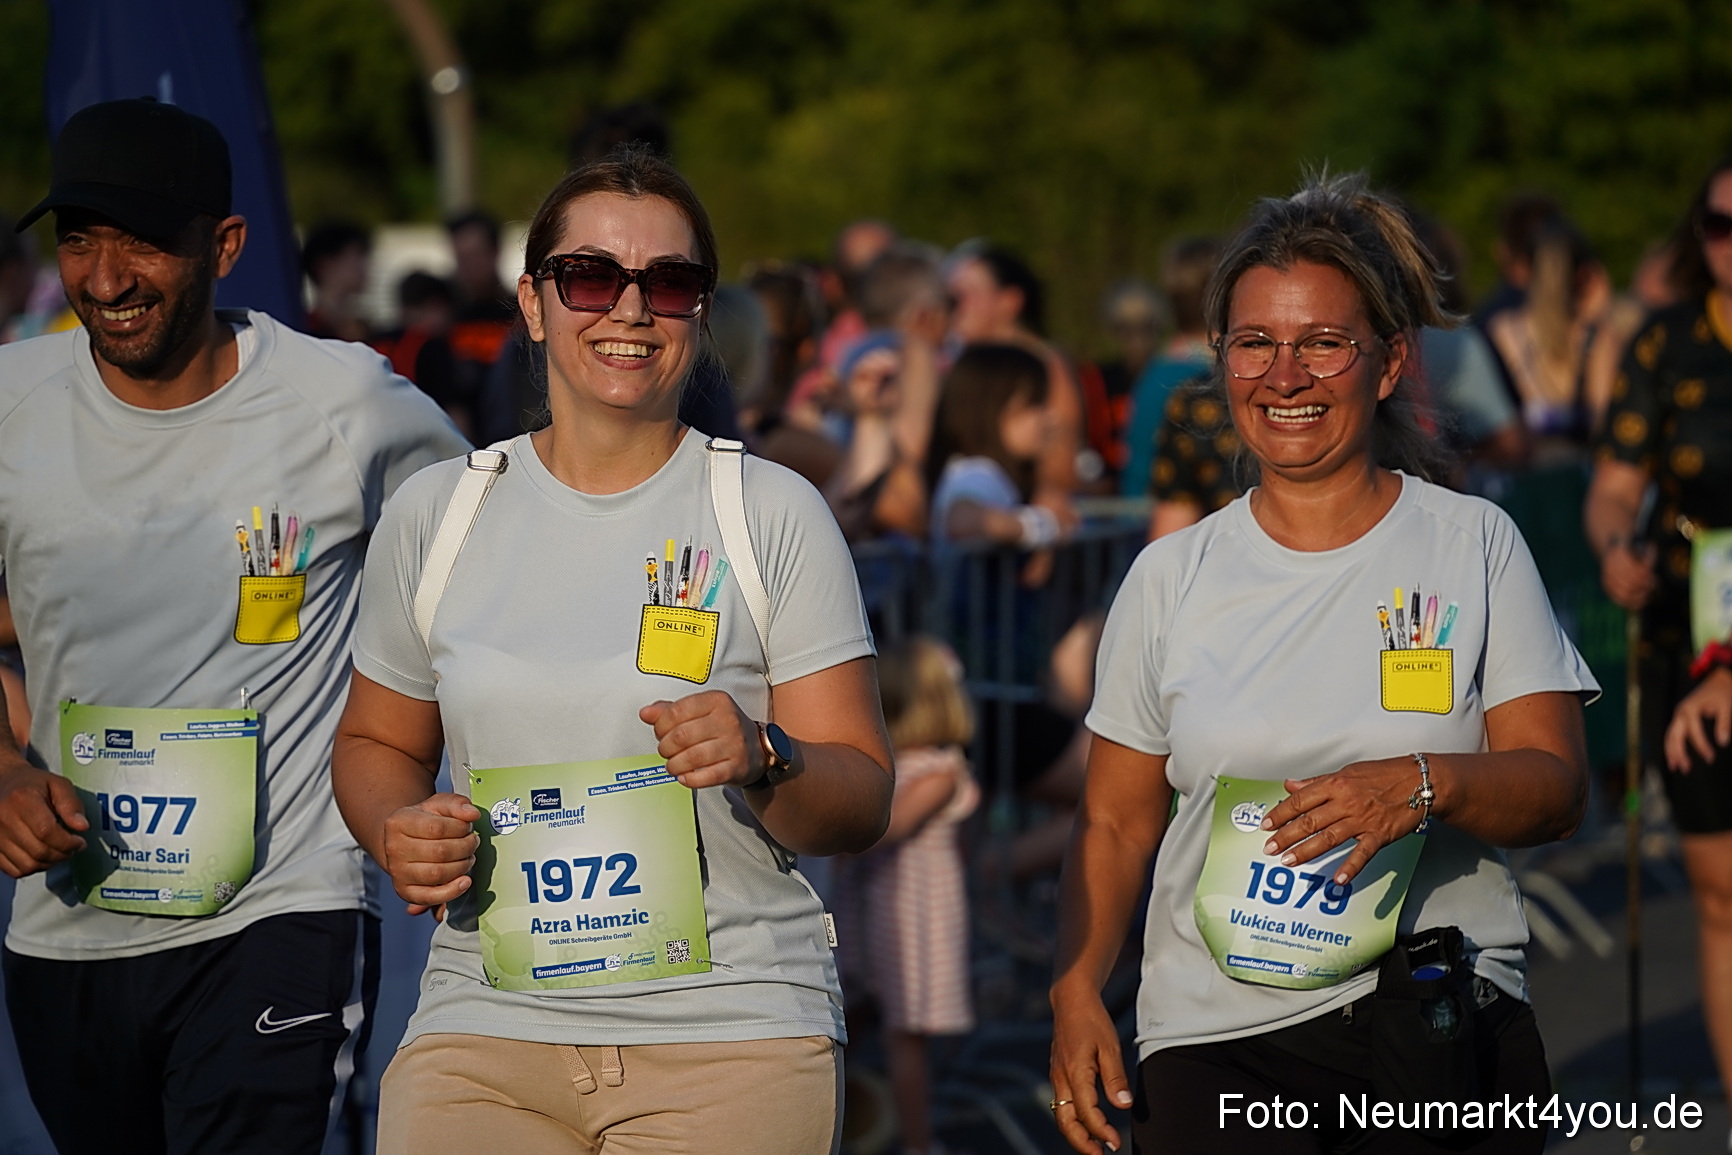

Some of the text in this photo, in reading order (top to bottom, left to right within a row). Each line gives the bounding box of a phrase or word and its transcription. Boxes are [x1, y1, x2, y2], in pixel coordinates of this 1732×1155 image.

[98, 748, 156, 759] Firmenlauf
[97, 792, 197, 835] 1977
[524, 805, 585, 824] Firmenlauf
[548, 817, 585, 829] neumarkt
[111, 845, 190, 864] Omar Sari
[520, 852, 642, 904] 1972
[1245, 860, 1354, 917] 1979
[530, 908, 650, 935] Azra Hamzic
[1229, 908, 1353, 948] Vukica Werner
[549, 931, 632, 946] ONLINE Schreibgeräte GmbH
[535, 961, 603, 977] firmenlauf.bayern
[1229, 956, 1290, 973] firmenlauf.bayern
